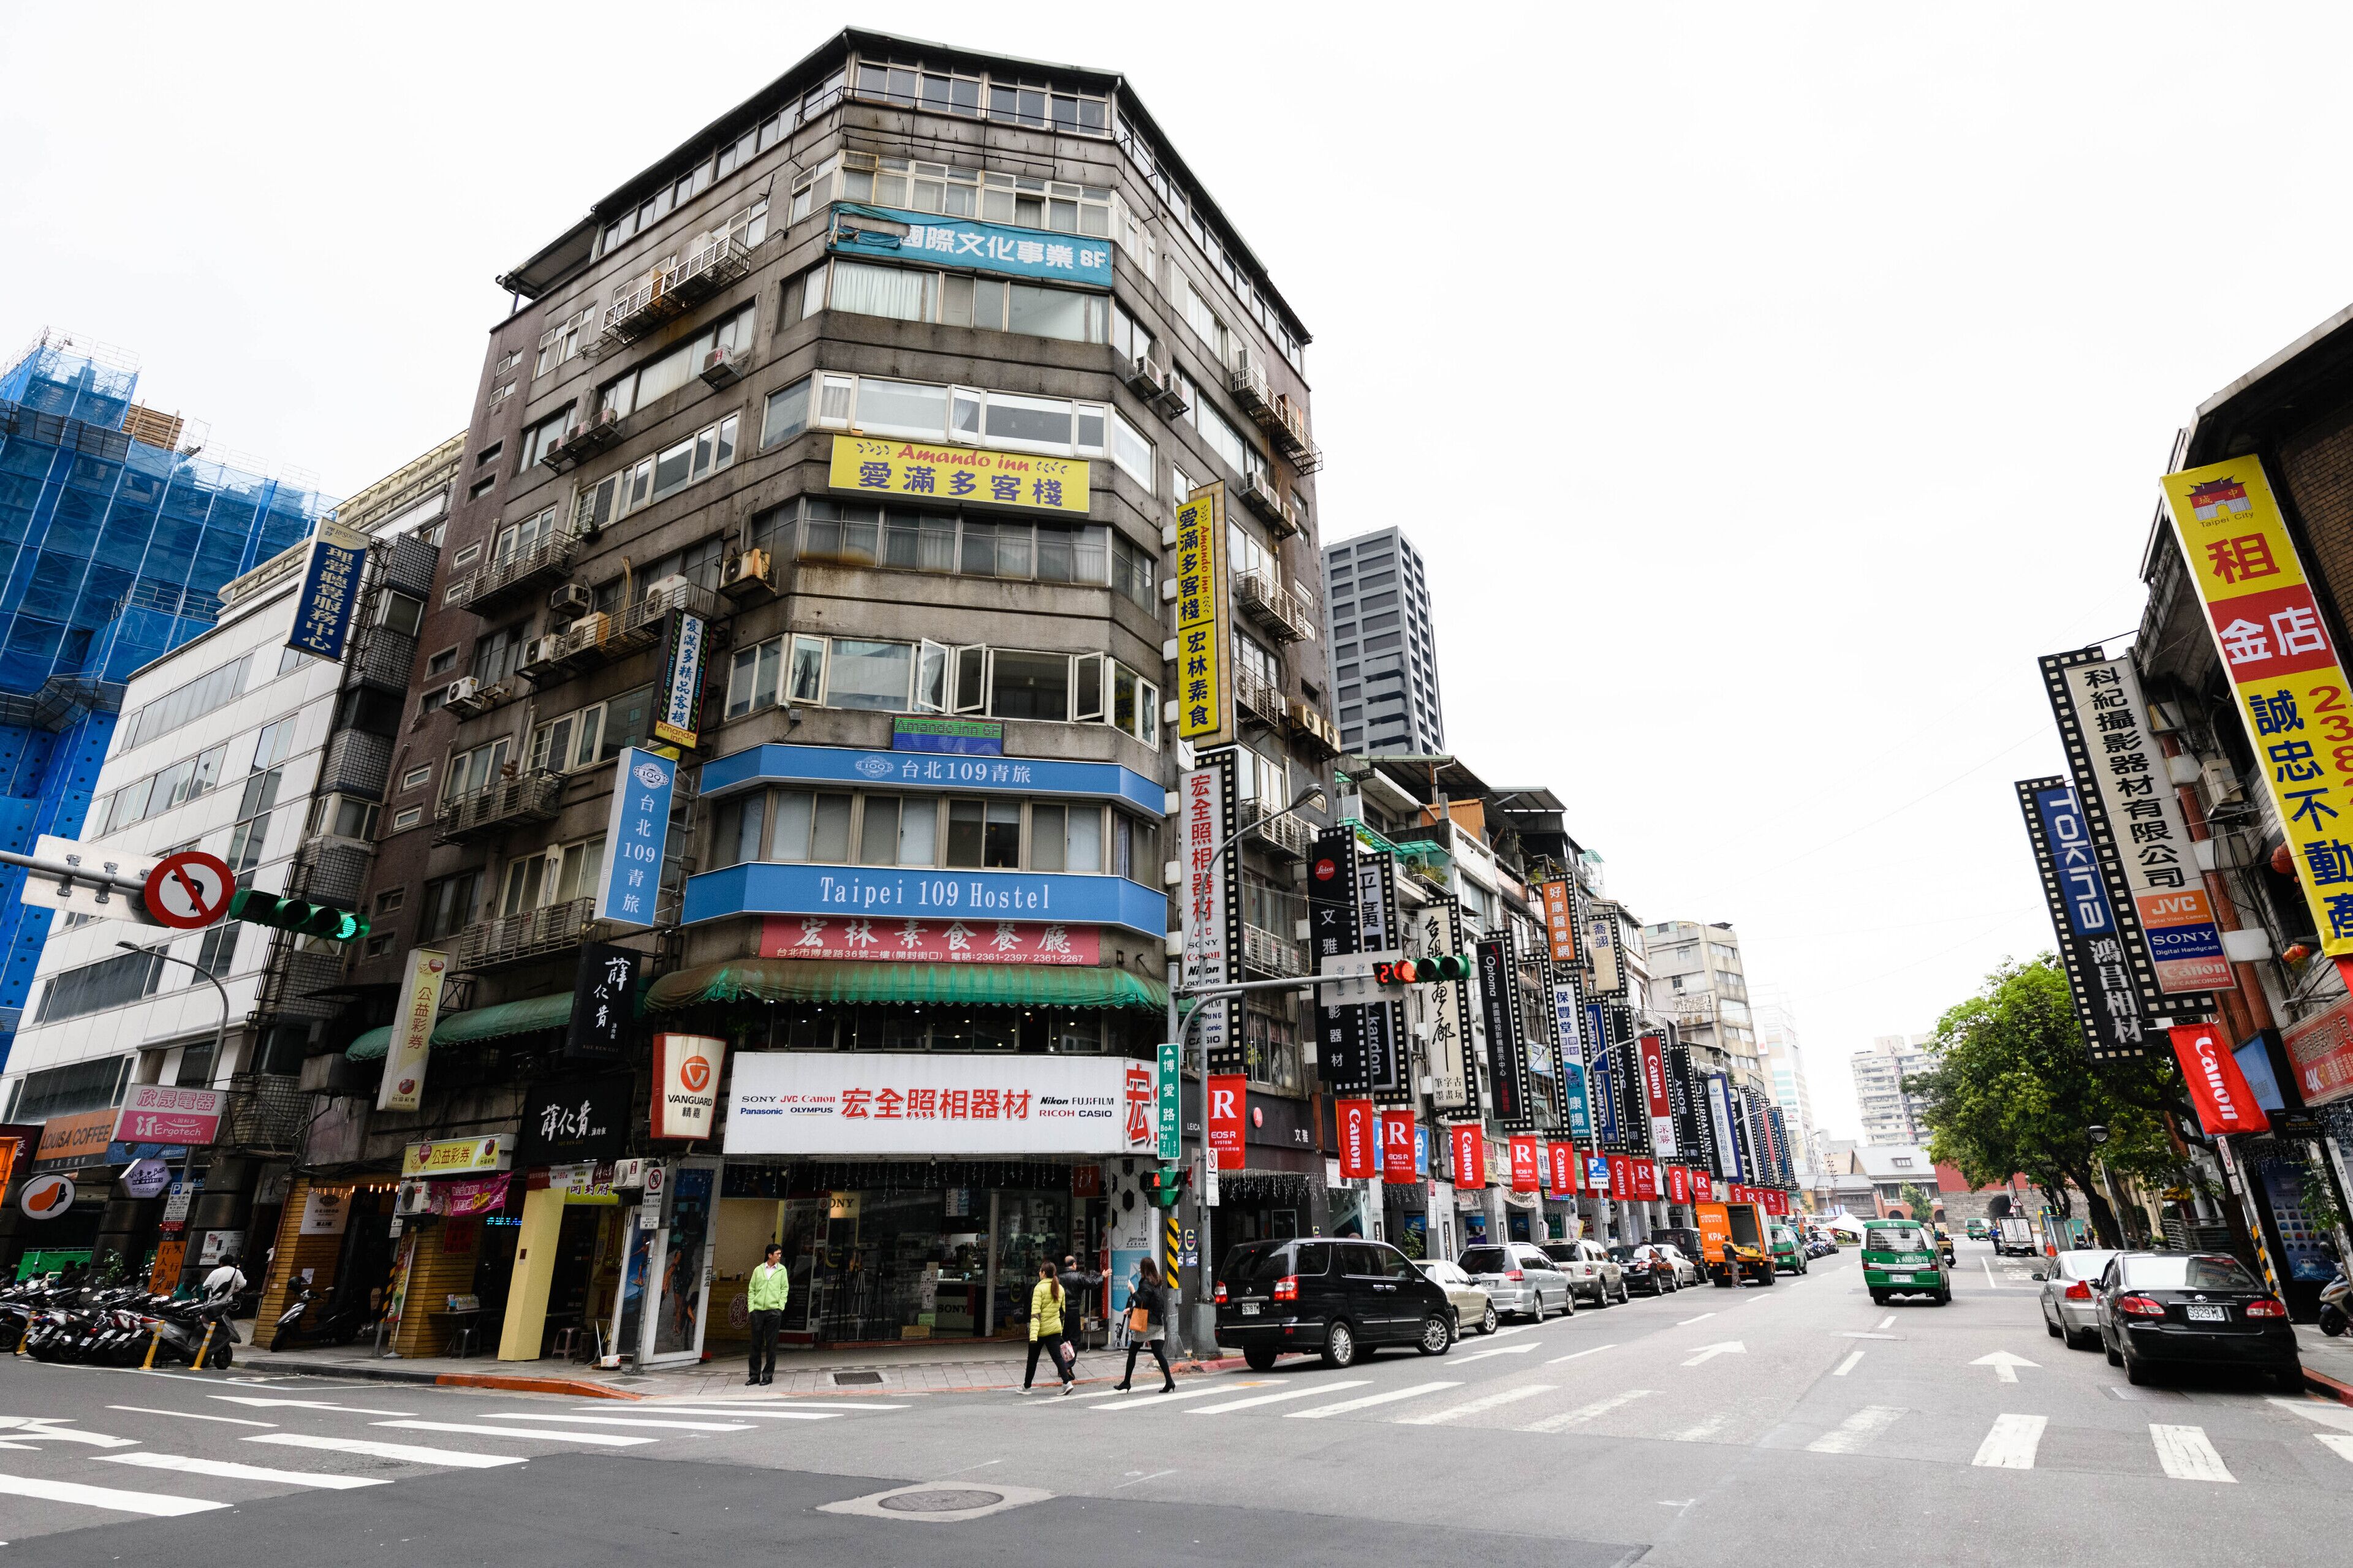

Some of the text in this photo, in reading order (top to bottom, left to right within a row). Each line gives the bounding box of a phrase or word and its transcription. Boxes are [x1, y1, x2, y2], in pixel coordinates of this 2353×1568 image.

[1080, 249, 1107, 268] 8F
[898, 443, 1030, 472] Amando inn
[858, 461, 1063, 507] 愛滿多客棧
[2199, 511, 2254, 528] Taipei City
[1178, 507, 1200, 622] 愛滿多客棧
[1200, 526, 1212, 593] Amando inn
[2205, 532, 2281, 585] 租
[301, 545, 355, 651] 理聲聽覺服務中心
[2219, 606, 2327, 665] 金店
[665, 655, 675, 687] Amando
[671, 618, 700, 728] 愛滿多精品客棧
[694, 666, 704, 698] Amando
[1187, 631, 1208, 728] 宏林素食
[657, 722, 695, 741] Amando
[895, 720, 954, 735] Amando
[642, 771, 661, 782] 109
[901, 759, 1031, 784] 台北109青旅
[2084, 667, 2187, 889] 科紀攝影器材有限公司
[621, 794, 656, 914] 台北109青旅
[1191, 773, 1214, 923] 宏全照相器材
[1316, 865, 1336, 876] Leica
[820, 876, 1049, 909] Taipei 109 Hostel
[2151, 896, 2197, 915] JVC
[1194, 928, 1212, 937] JC
[1548, 886, 1570, 958] 好康醫療網
[794, 919, 1071, 954] 宏林素食餐廳
[2151, 930, 2213, 946] SONY
[2156, 944, 2219, 956] Digital Handycam
[1187, 952, 1219, 962] Caon
[1188, 966, 1220, 976] Nion
[2162, 963, 2227, 979] Canon
[1187, 977, 1221, 987] OLYPUS
[1380, 964, 1393, 983] 2
[1485, 955, 1497, 998] Optoma
[2179, 977, 2229, 987] CAMCORDER
[1320, 909, 1344, 1068] 文雅影器材
[2089, 937, 2143, 1044] 鴻昌相材
[407, 986, 433, 1050] 公益彩券
[1555, 991, 1572, 1034] 保豐堂
[1368, 1015, 1382, 1077] kardon
[1162, 1059, 1176, 1122] 博愛路
[1647, 1055, 1662, 1099] Canon
[2194, 1036, 2238, 1121] Canon
[2305, 1067, 2324, 1093] 4K
[136, 1088, 216, 1112] 欣晟電器
[667, 1094, 713, 1107] VANGUARD
[801, 1094, 836, 1104] Canon
[841, 1088, 1033, 1122] 宏全照相器材
[1040, 1096, 1115, 1106] Nikon FUJIFILM
[1126, 1064, 1158, 1148] 宏
[1210, 1089, 1237, 1119] R
[1594, 1074, 1607, 1128] OLYMPUS
[1675, 1078, 1688, 1115] SONY
[681, 1106, 702, 1119] 精嘉
[1039, 1109, 1113, 1118] RICOH CASIO
[1568, 1096, 1583, 1127] 康揚
[40, 1123, 112, 1151] LOUISA COFFEE
[154, 1123, 202, 1137] Ergotech
[1187, 1123, 1200, 1131] LEICA
[1211, 1131, 1229, 1139] EOS
[1294, 1128, 1309, 1143] 文雅
[1349, 1108, 1362, 1169] Canon
[1387, 1121, 1409, 1145] R
[432, 1146, 471, 1165] 公益彩券
[1462, 1131, 1474, 1182] Canon
[1514, 1144, 1533, 1163] R
[154, 1166, 166, 1177] BAR
[1555, 1148, 1566, 1189] Canon
[1615, 1160, 1626, 1195] Canon
[1637, 1165, 1651, 1180] R
[1696, 1176, 1708, 1189] R
[1674, 1170, 1683, 1200] Canon
[1767, 1193, 1776, 1202] R
[1901, 1255, 1929, 1265] ANN-5919
